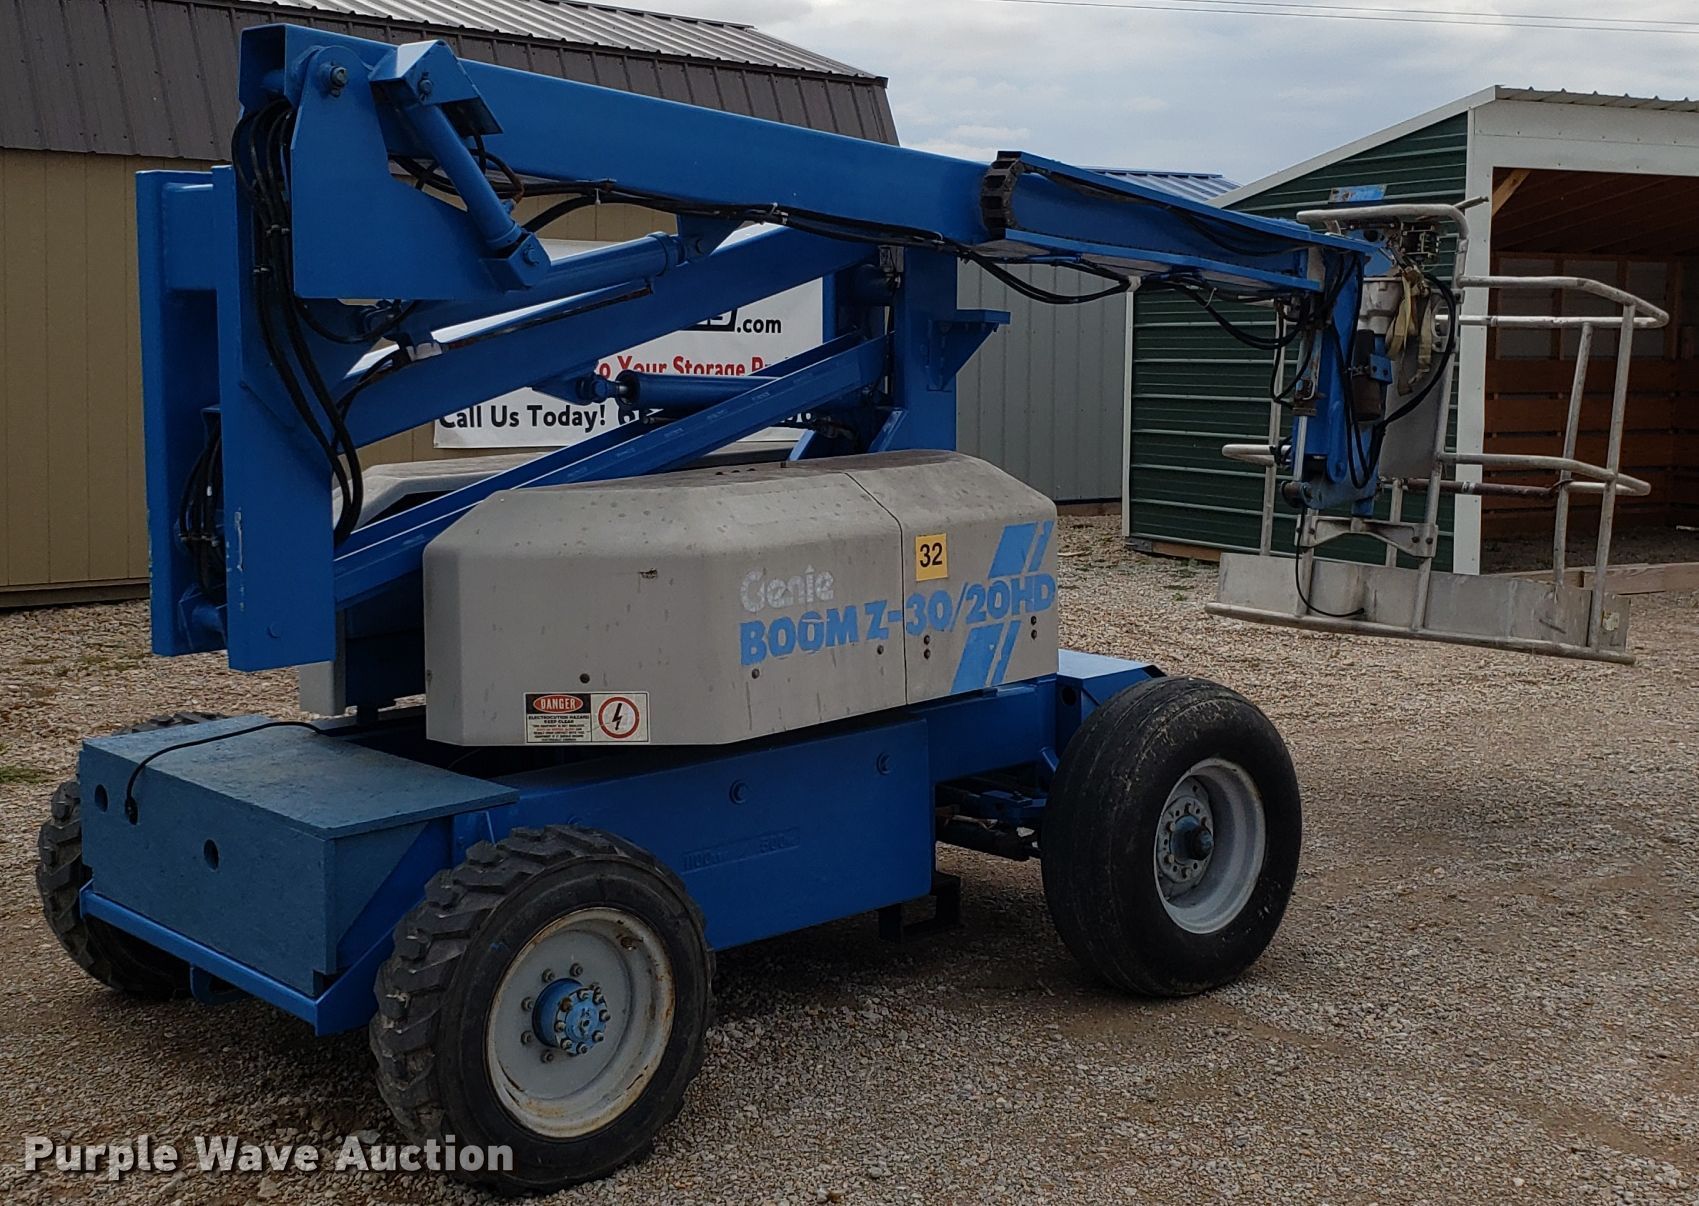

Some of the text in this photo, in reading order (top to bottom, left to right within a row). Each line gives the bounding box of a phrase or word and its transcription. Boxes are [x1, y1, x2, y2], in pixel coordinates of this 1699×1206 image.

[736, 318, 782, 334] .com
[673, 355, 746, 376] Storage
[490, 404, 520, 428] Us
[526, 404, 606, 434] Today!
[919, 542, 943, 568] 32
[739, 564, 834, 613] Genie
[739, 605, 860, 667] BOOM
[541, 698, 576, 710] DANGER
